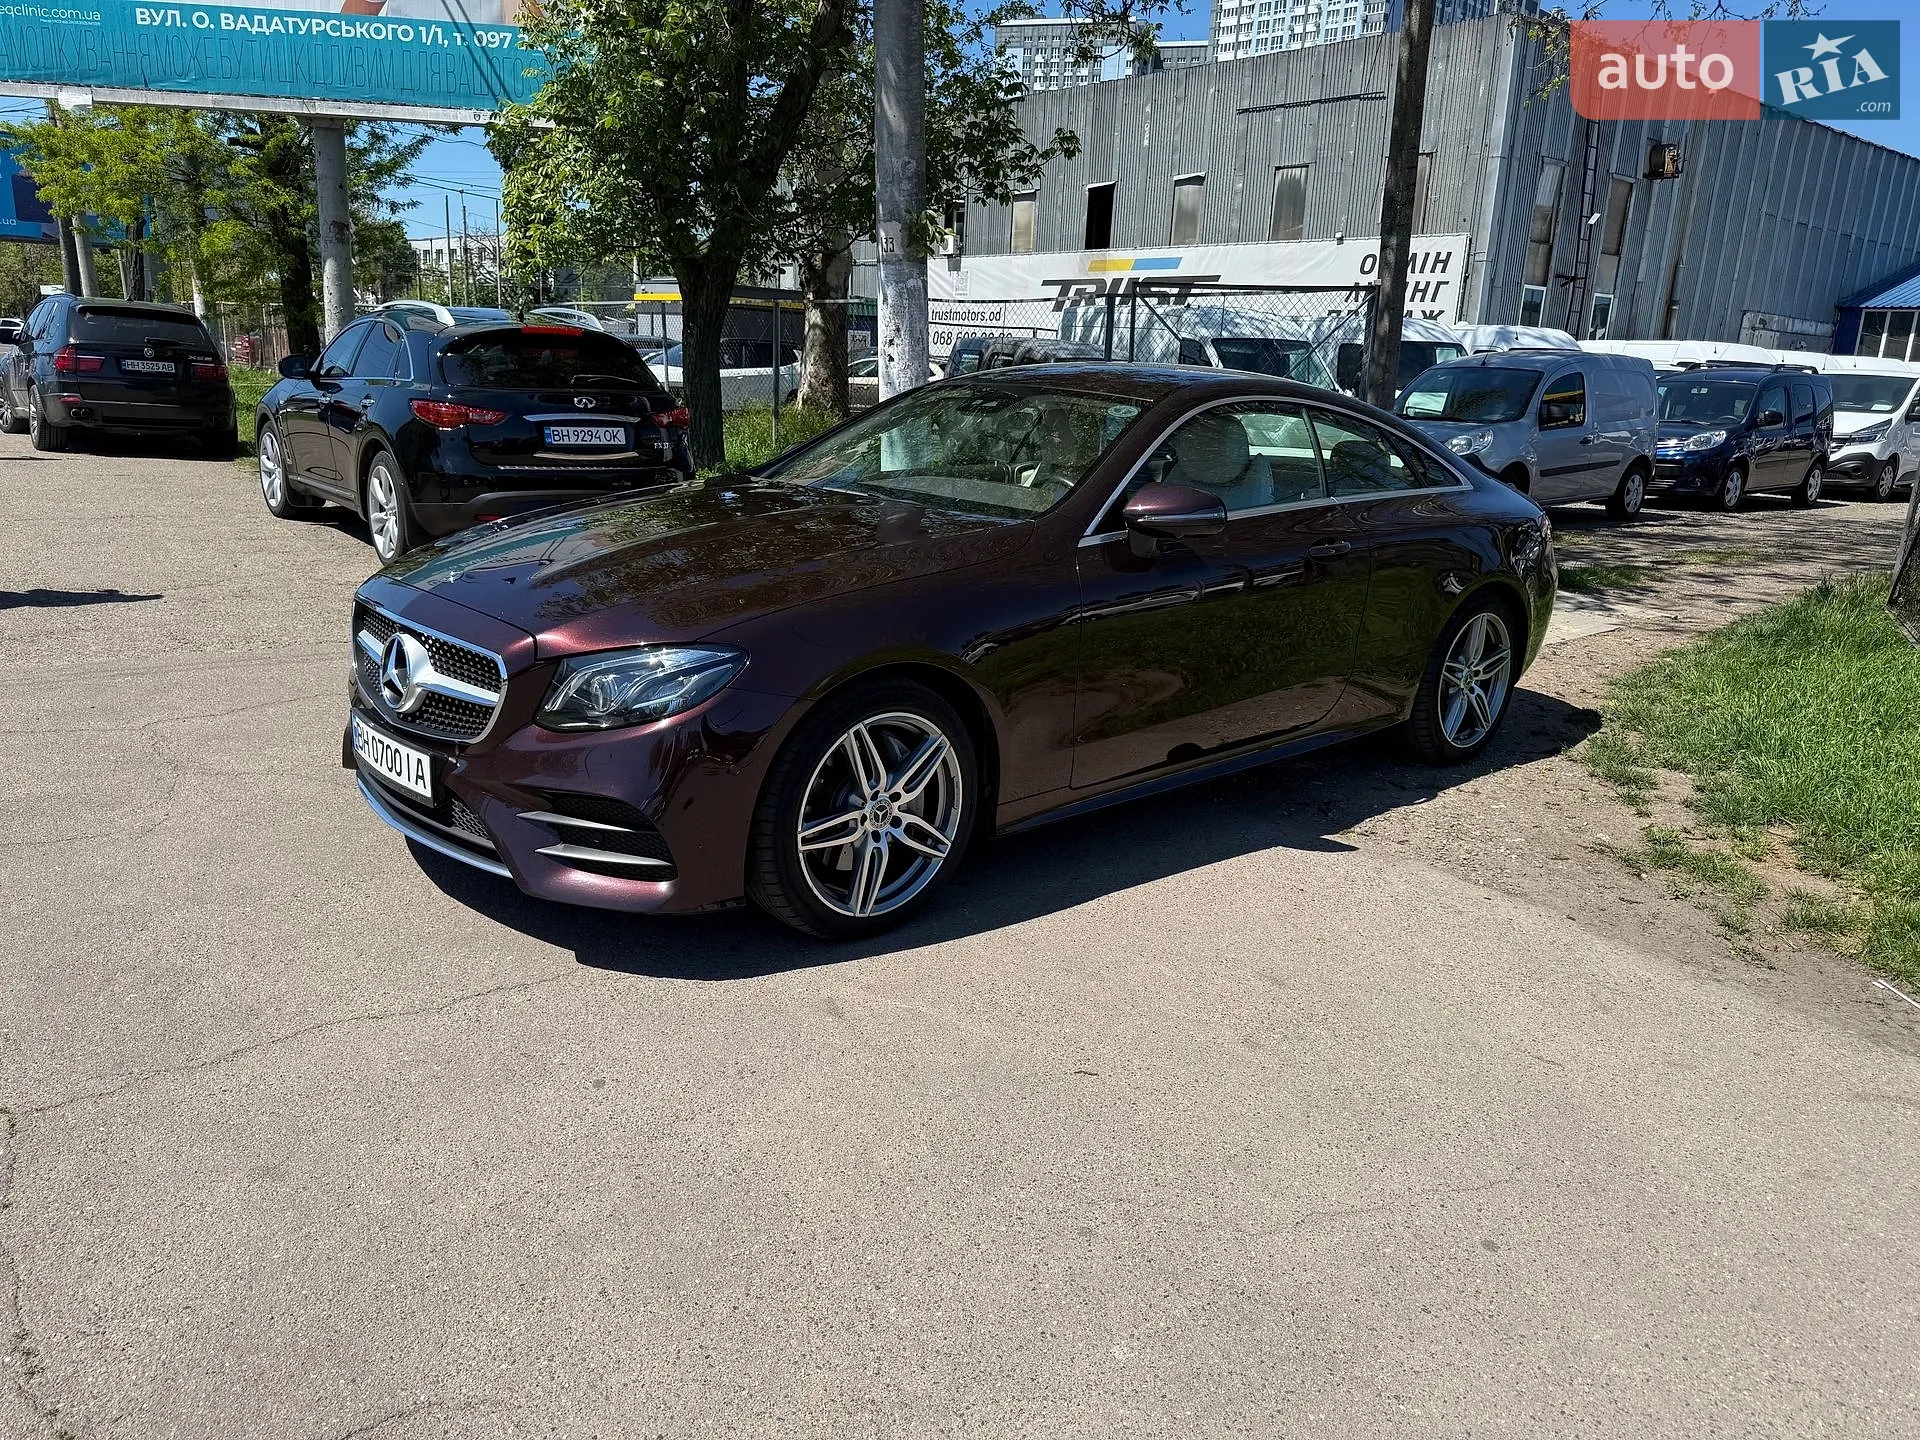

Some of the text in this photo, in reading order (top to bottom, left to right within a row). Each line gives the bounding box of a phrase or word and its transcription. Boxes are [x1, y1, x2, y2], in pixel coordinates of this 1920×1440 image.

[135, 7, 187, 28] ВУЛ.
[192, 11, 215, 29] О.
[219, 13, 414, 42] ВАДАТУРСЬКОГО
[418, 24, 449, 48] 1/1,
[473, 30, 512, 49] 097
[1040, 274, 1222, 313] TRUST
[932, 331, 953, 346] 068
[552, 429, 622, 443] BH 9294 OK
[356, 721, 427, 790] BH 0700 IA
